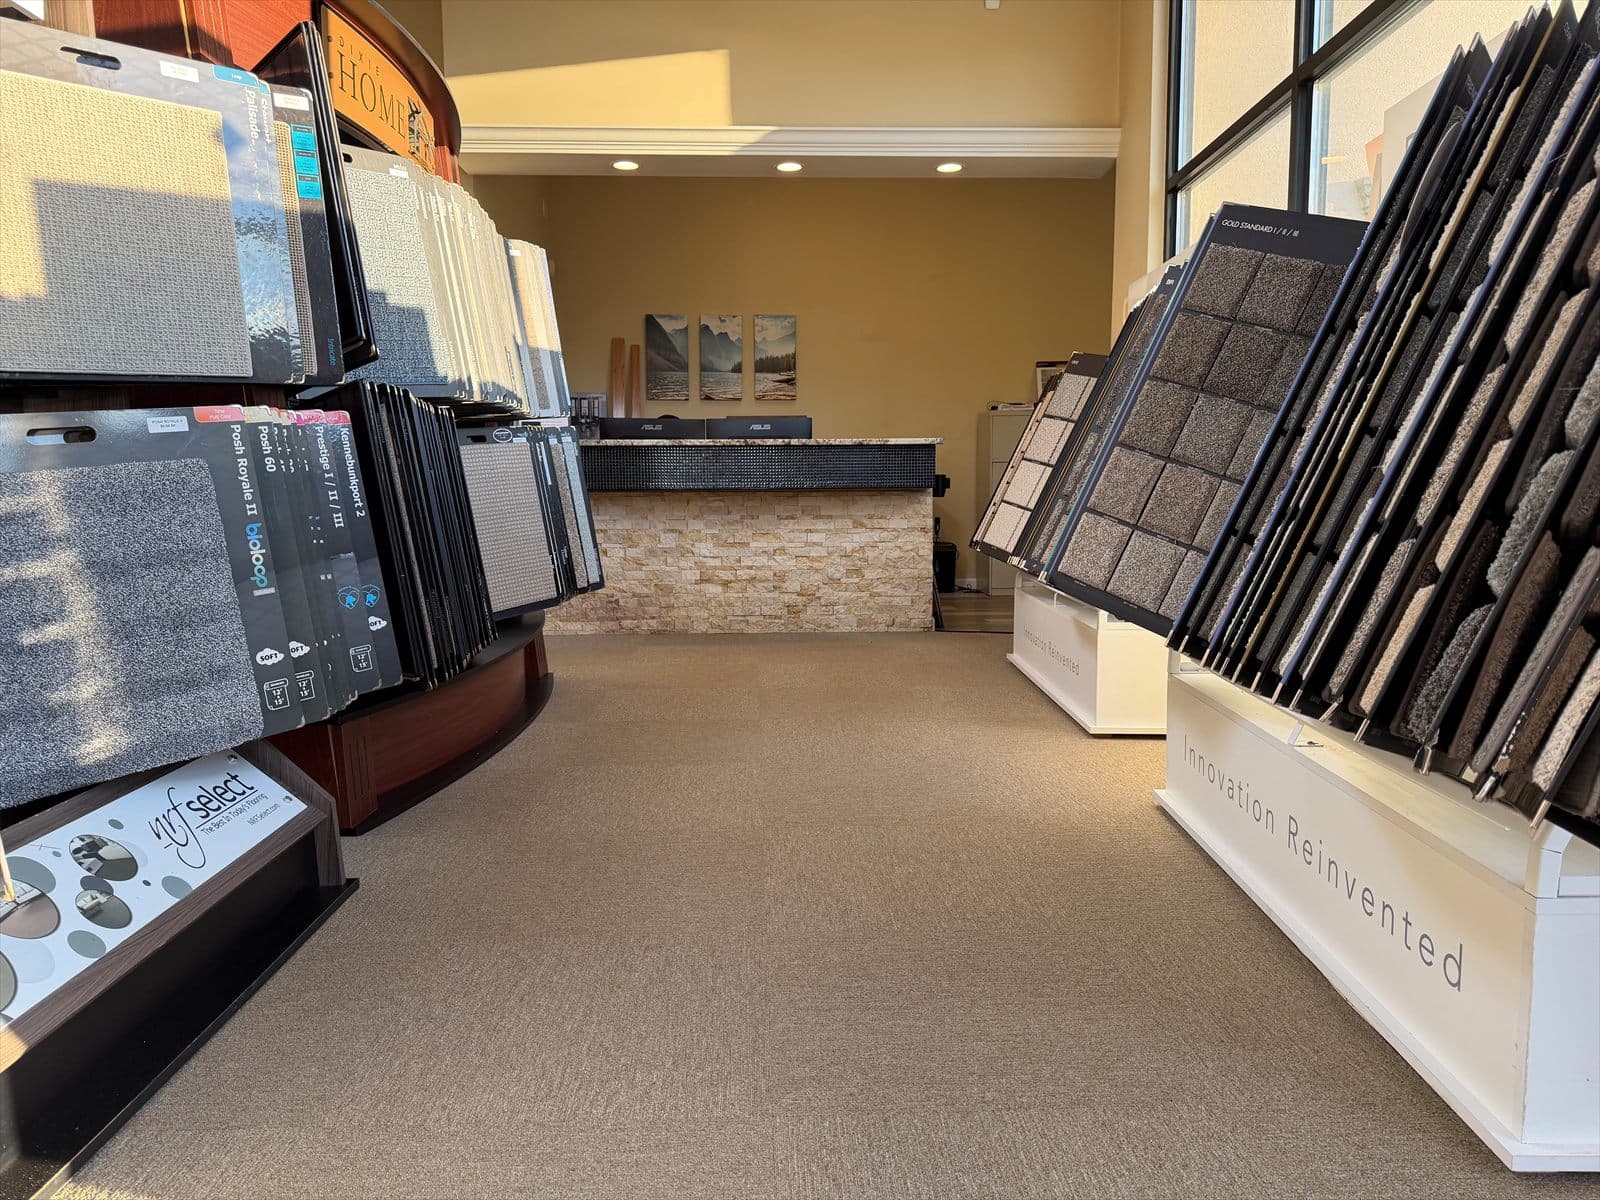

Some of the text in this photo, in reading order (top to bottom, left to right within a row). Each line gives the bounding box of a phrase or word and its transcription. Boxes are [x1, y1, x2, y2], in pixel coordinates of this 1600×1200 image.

[339, 36, 379, 76] DIXIE
[245, 89, 260, 139] Palisade
[337, 50, 405, 139] HOME
[1222, 219, 1240, 228] GOLD
[1240, 221, 1273, 233] STANDARD
[231, 425, 257, 516] Posh Royale II
[258, 426, 276, 472] Posh 60
[340, 427, 365, 518] Kennebunkport 2
[315, 426, 330, 470] Prestige
[328, 490, 338, 500] II
[333, 512, 344, 528] III
[245, 522, 268, 588] bioloop
[260, 653, 278, 661] SOFT
[290, 645, 304, 653] OFT
[1024, 624, 1080, 676] Innovation Reinvented
[186, 772, 254, 819] select
[201, 825, 215, 836] The
[211, 819, 227, 831] Best
[229, 802, 249, 819] Today's
[246, 793, 269, 808] Flooring
[1184, 734, 1464, 992] Innovation Reinvented
